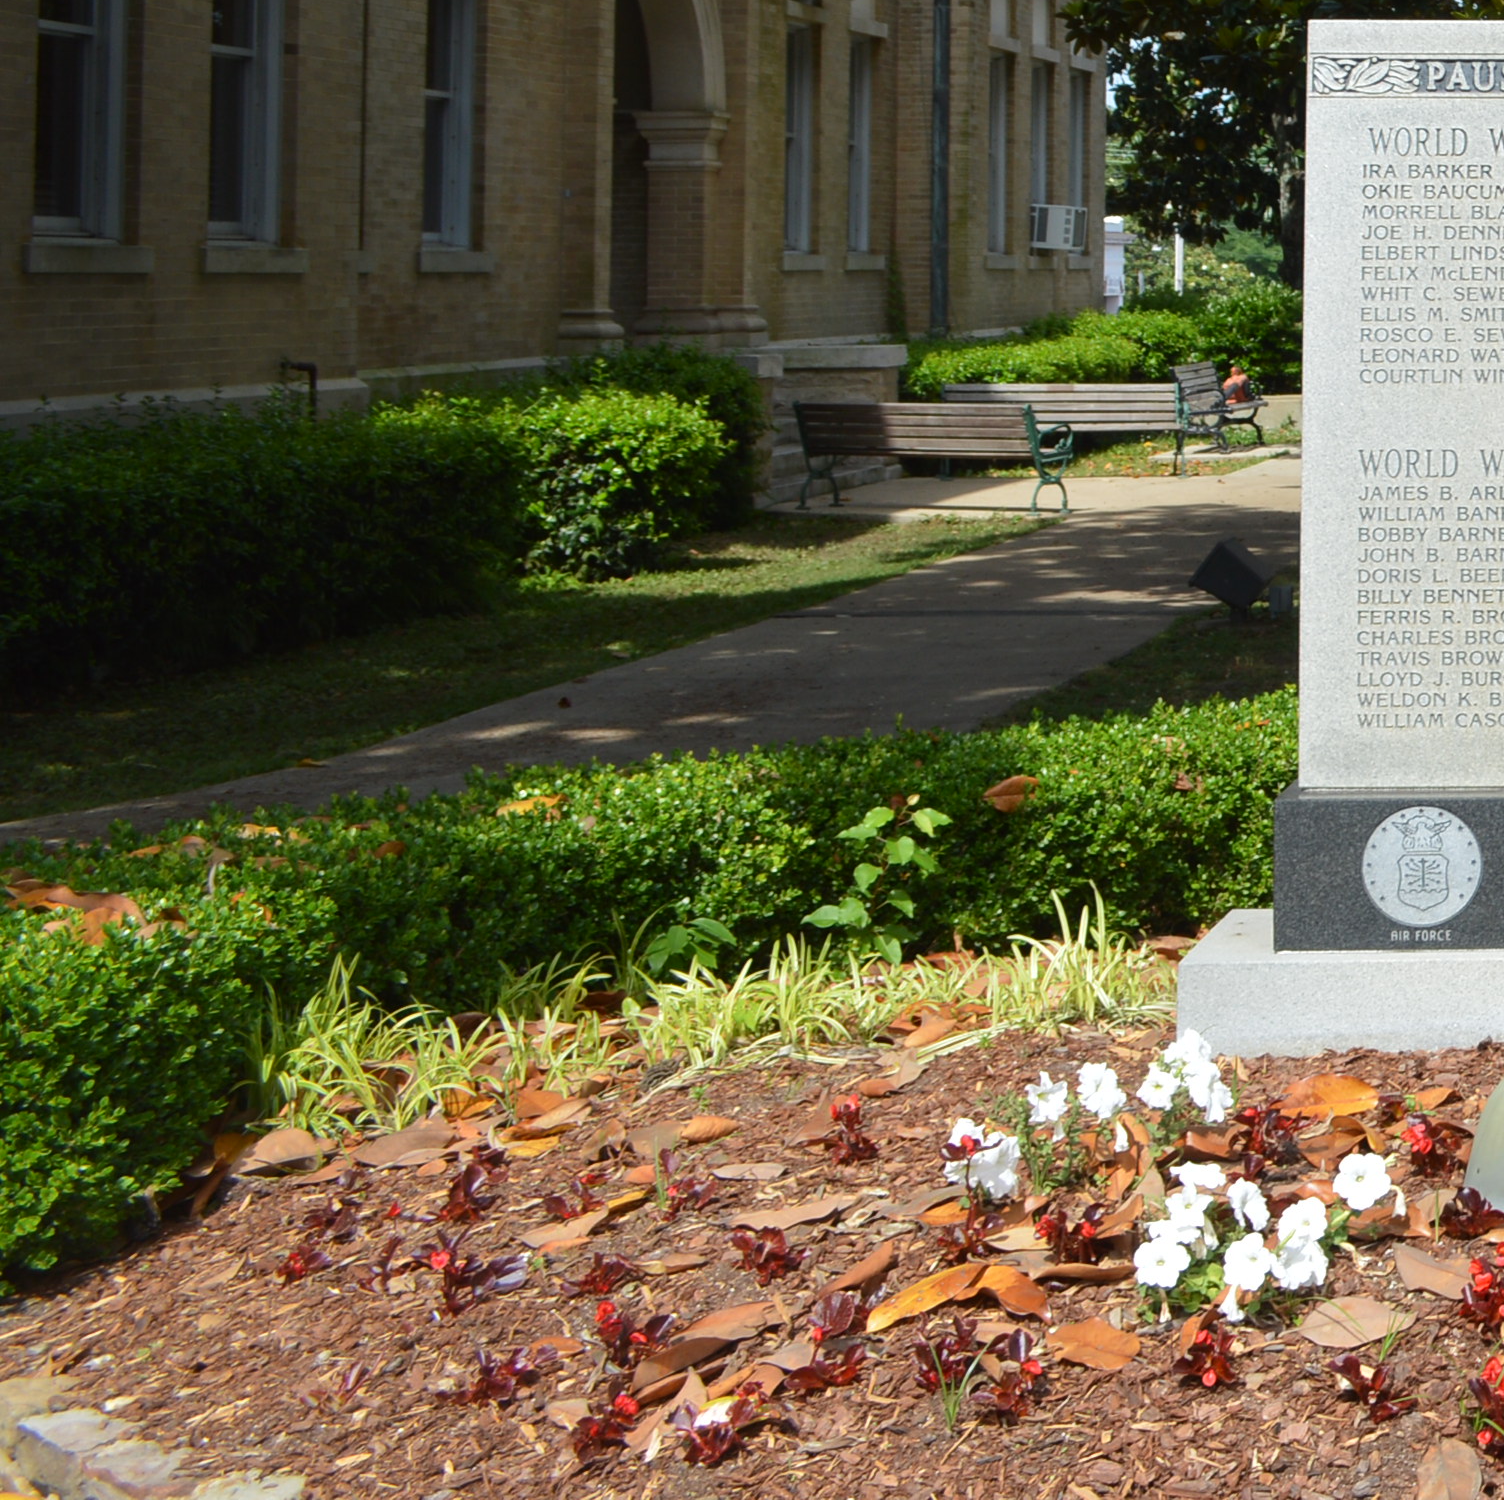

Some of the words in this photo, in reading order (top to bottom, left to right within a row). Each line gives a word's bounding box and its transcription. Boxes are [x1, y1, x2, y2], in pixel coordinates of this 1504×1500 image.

[1368, 127, 1468, 156] WORLD
[1363, 164, 1396, 178] IRA
[1409, 164, 1492, 179] BARKER
[1362, 185, 1412, 199] OKIE
[1362, 205, 1461, 219] MORRELL
[1362, 246, 1440, 260] ELBERT
[1362, 266, 1418, 281] FELIX
[1360, 349, 1459, 363] LEONARD
[1360, 369, 1463, 384] COURTLIN
[1358, 449, 1458, 478] WORLD
[1359, 507, 1444, 522] WILLIAM
[1358, 527, 1428, 542] BOBBY
[1358, 548, 1414, 563] JOHN
[1426, 548, 1444, 562] B.
[1358, 590, 1412, 605] BILLY
[1357, 631, 1453, 646] CHARLES
[1357, 651, 1431, 666] TRAVIS
[1357, 672, 1423, 687] LLOYD
[1433, 672, 1449, 686] J.
[1357, 713, 1444, 729] WILLIAM
[1391, 931, 1409, 941] AIR
[1416, 930, 1451, 941] FORCE
